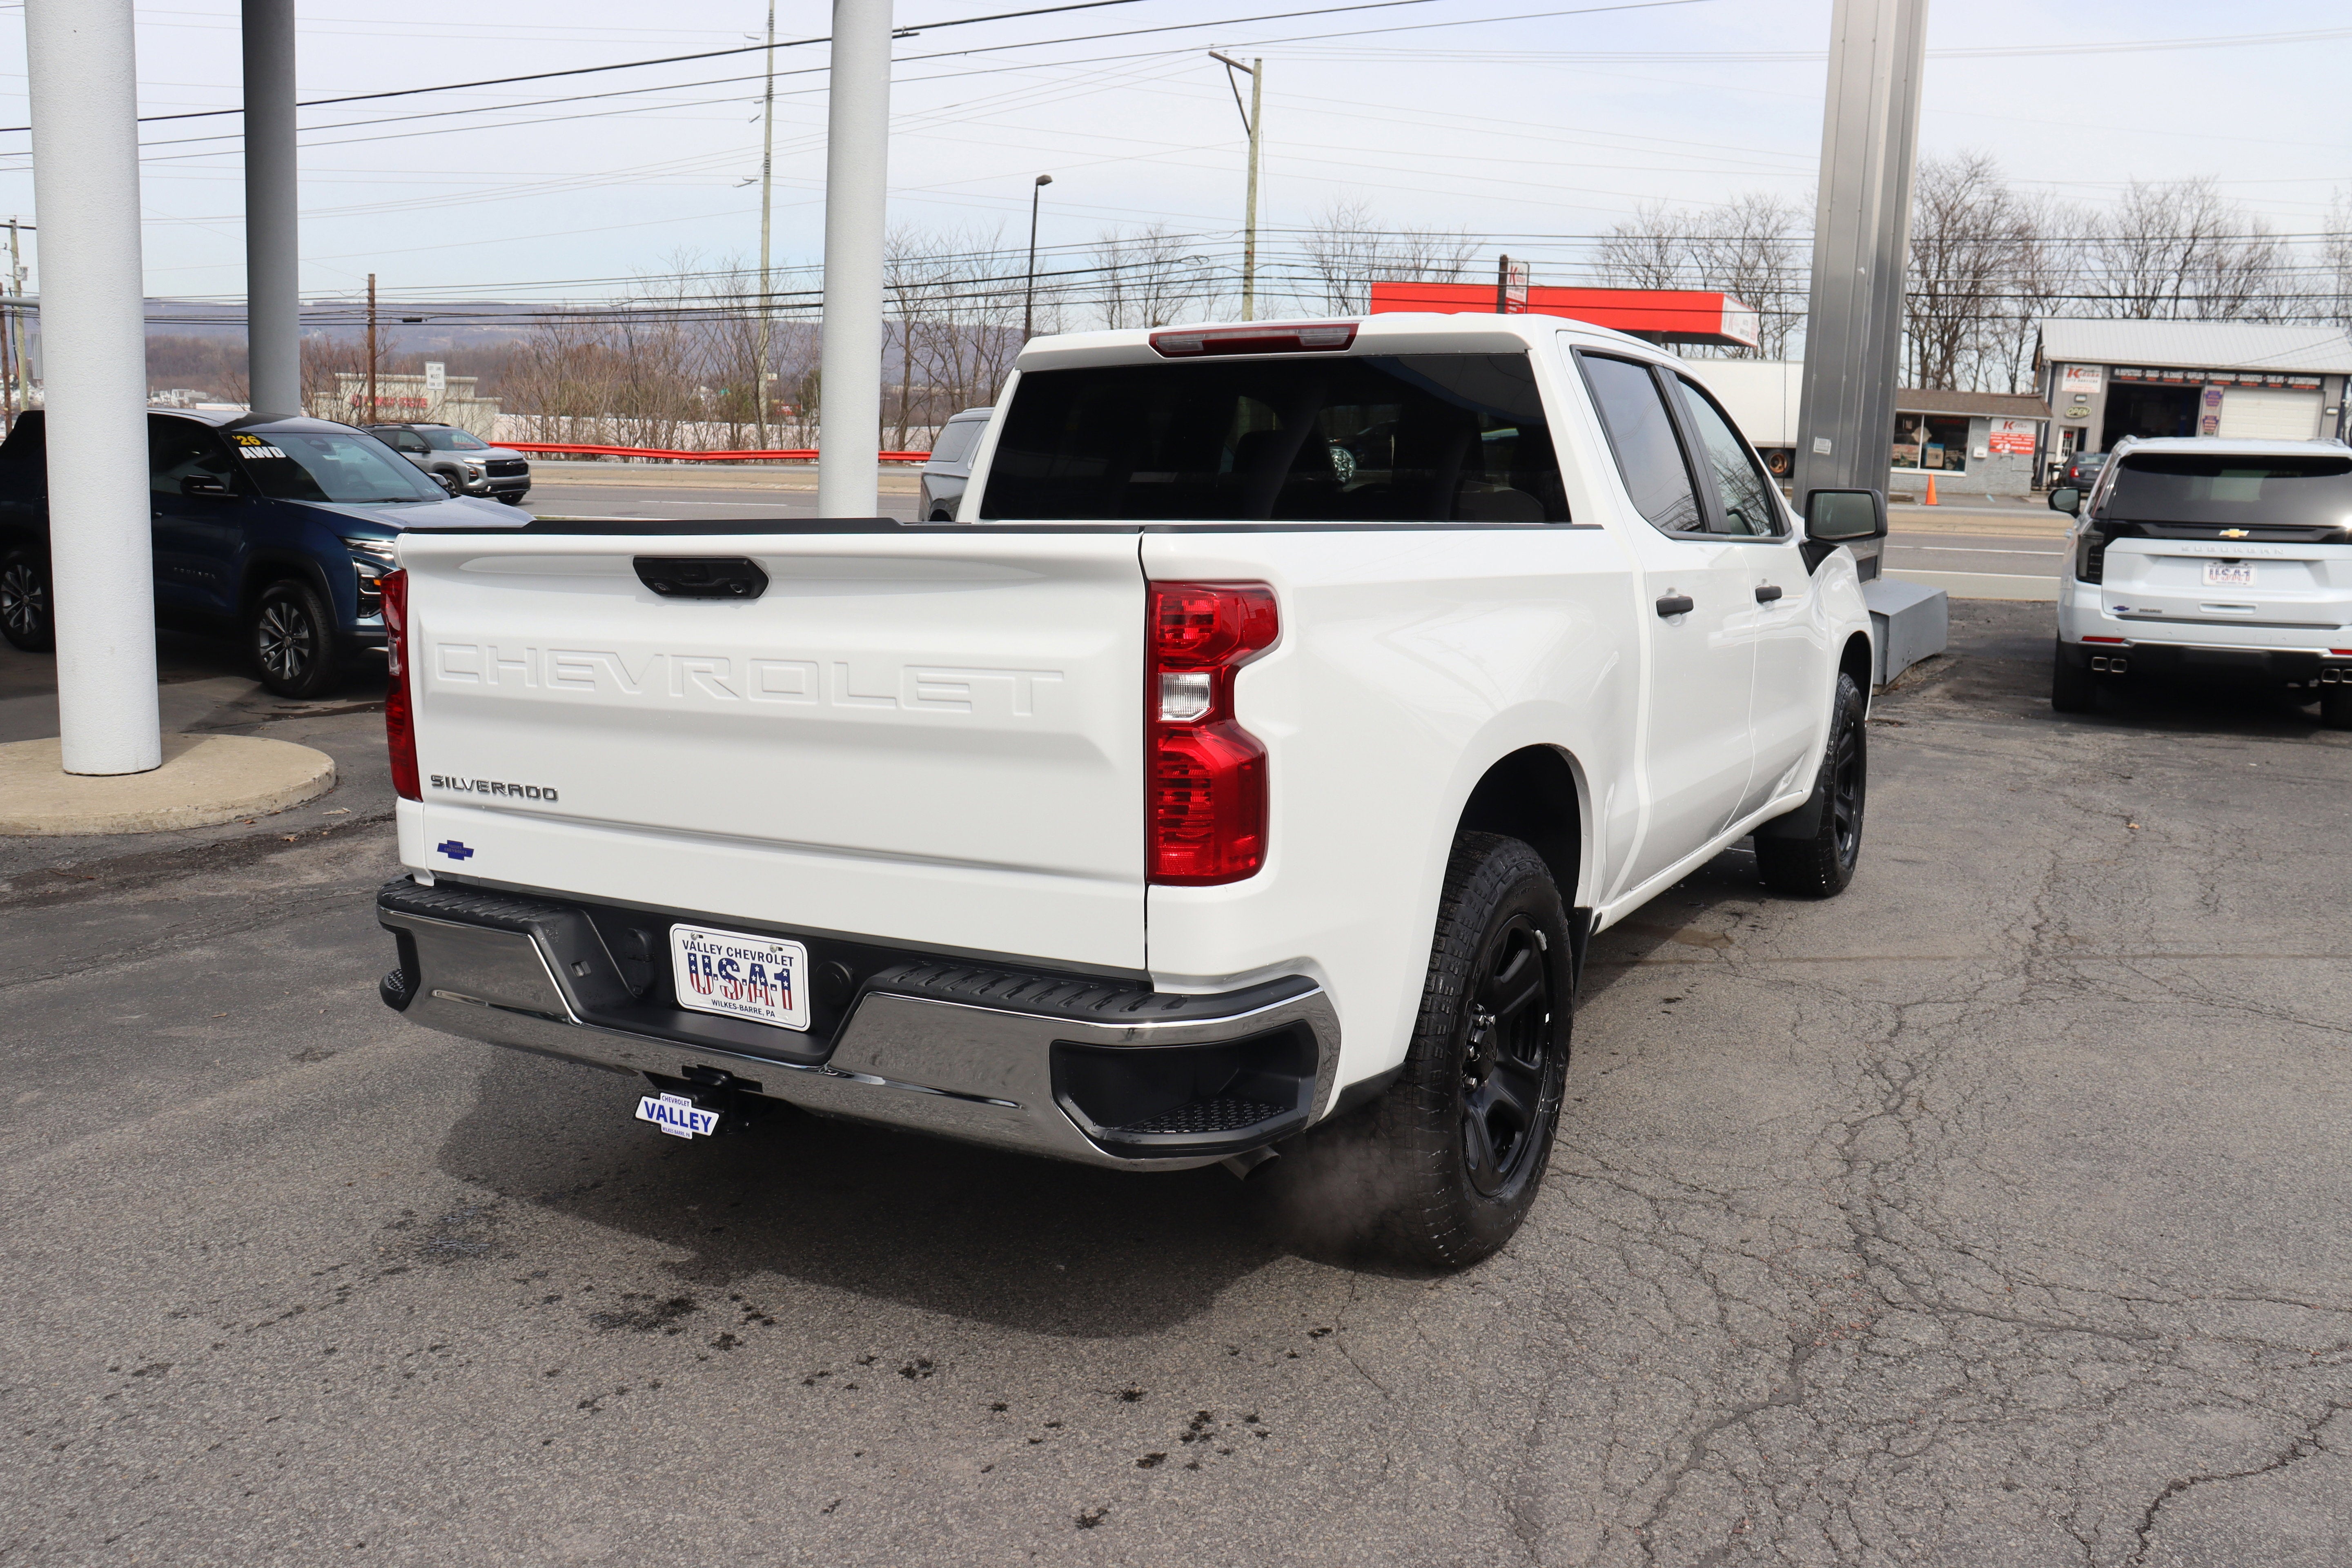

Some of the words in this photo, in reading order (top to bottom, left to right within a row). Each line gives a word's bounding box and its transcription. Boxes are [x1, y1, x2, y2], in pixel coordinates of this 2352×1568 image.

[232, 435, 261, 445] '26
[238, 446, 287, 459] AWD
[436, 642, 1065, 716] CHEVROLET
[431, 774, 559, 800] SILVERADO
[682, 940, 722, 955] VALLEY
[726, 947, 794, 967] CHEVROLET
[711, 999, 764, 1016] WILKES-BARRE,
[662, 1096, 690, 1107] CHEVROLET
[644, 1100, 712, 1133] VALLEY
